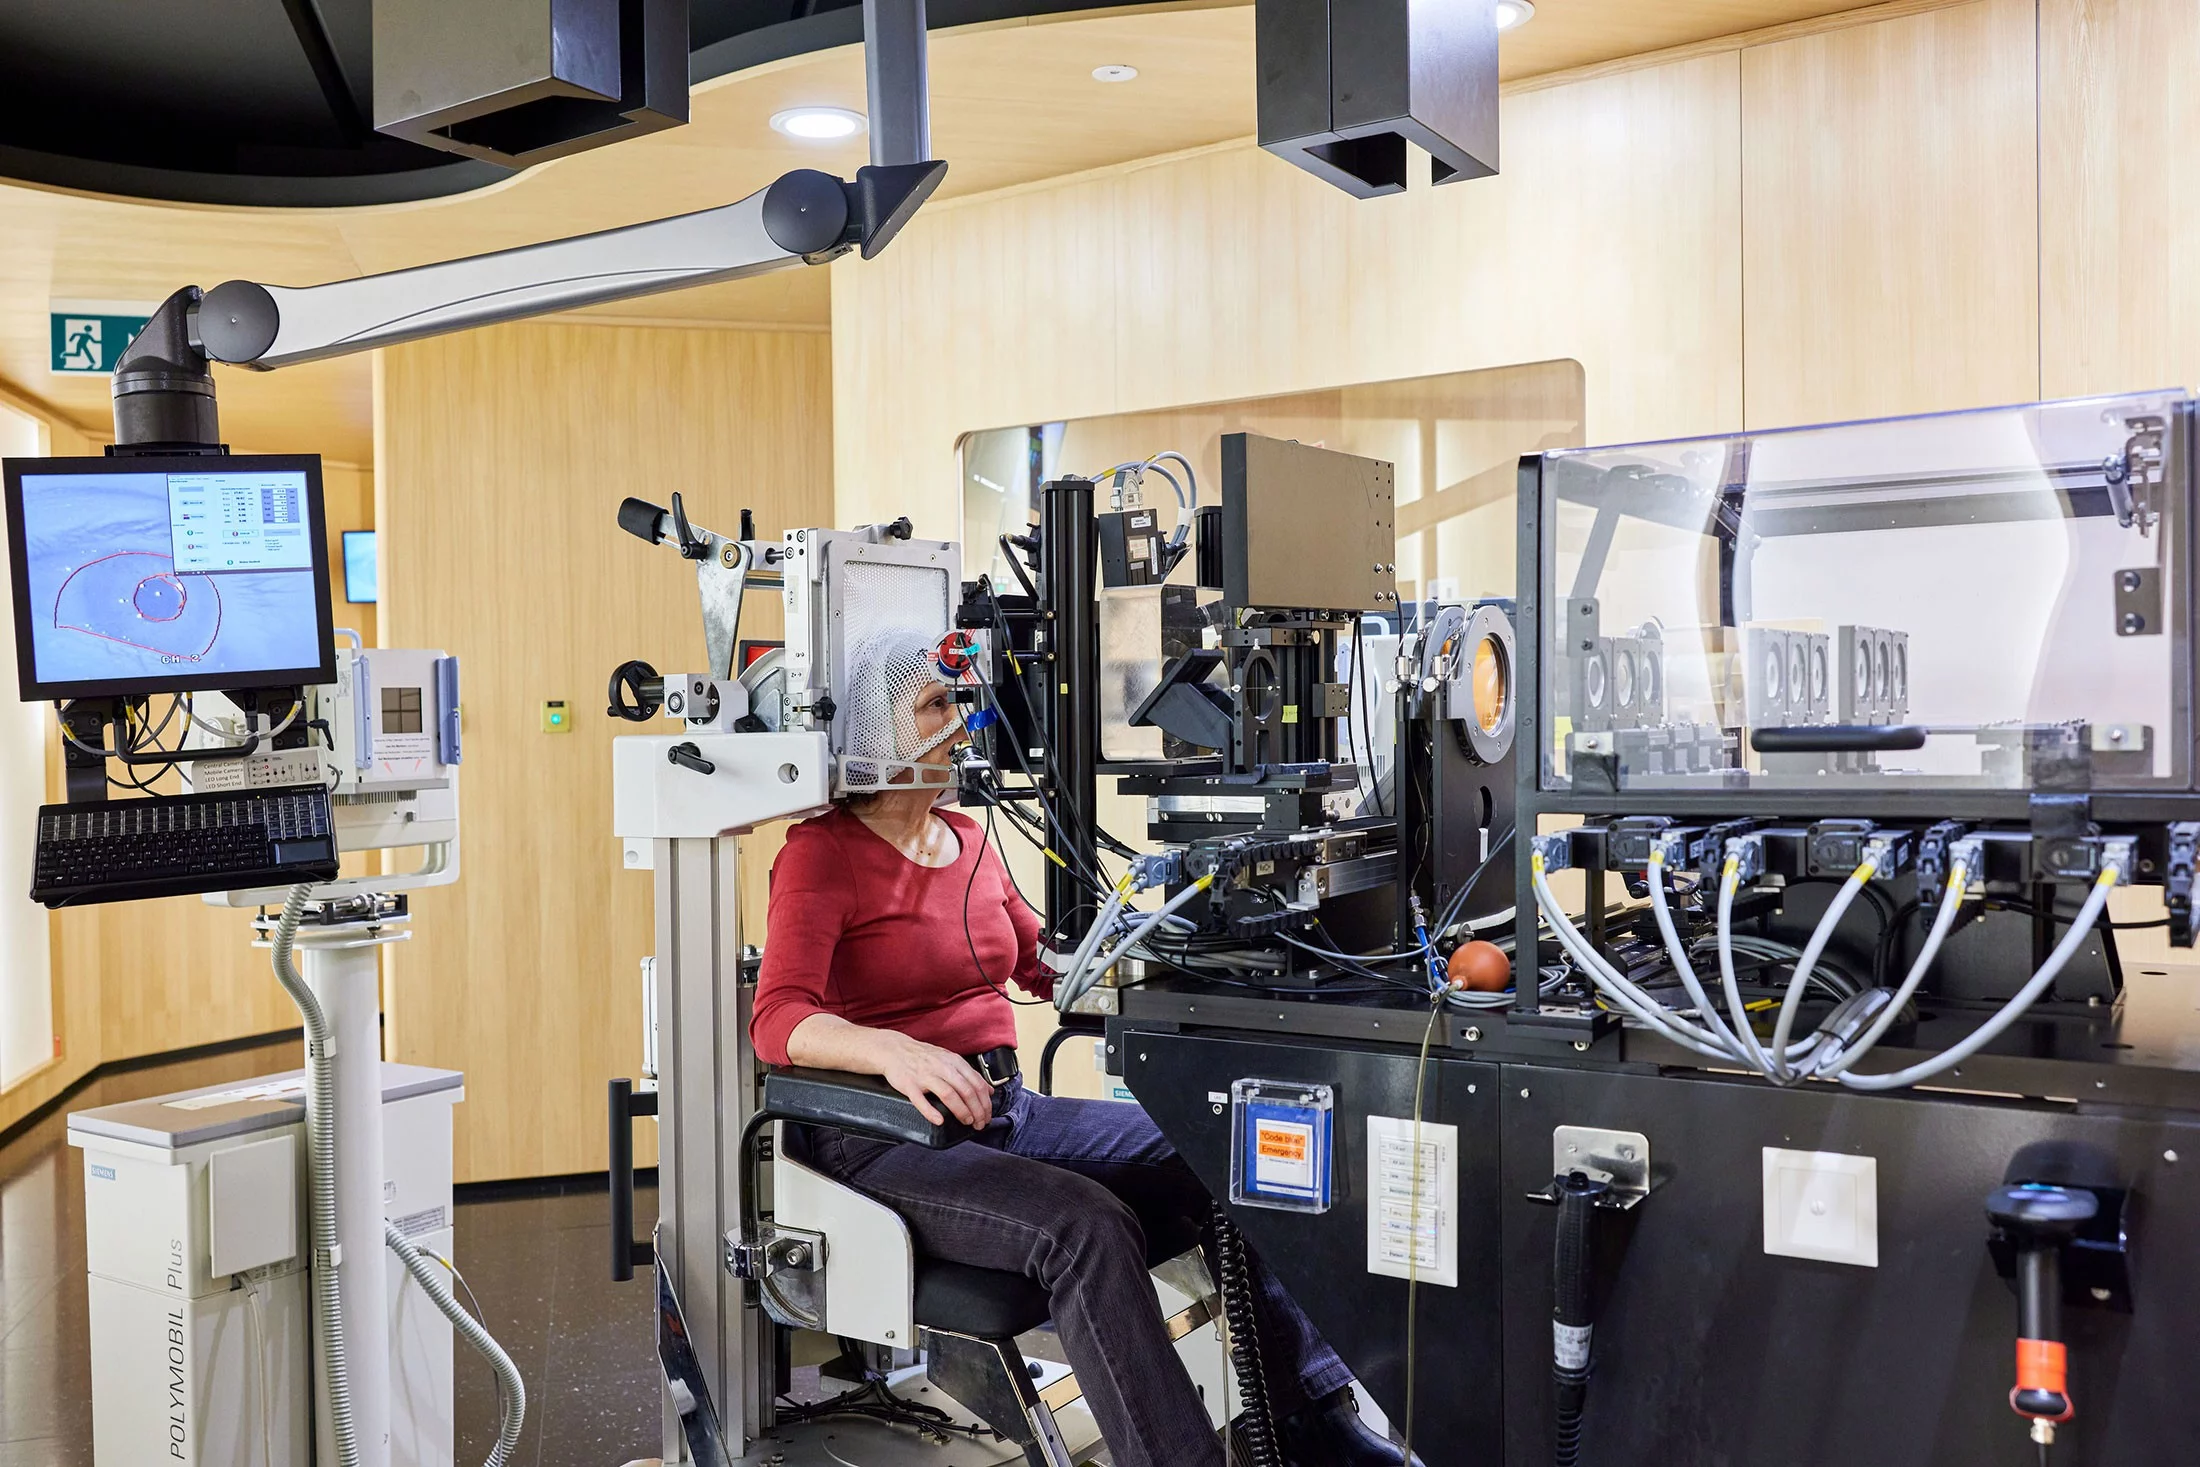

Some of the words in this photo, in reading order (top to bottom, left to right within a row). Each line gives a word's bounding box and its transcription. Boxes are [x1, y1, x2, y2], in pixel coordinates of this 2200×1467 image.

[161, 655, 180, 664] CH
[190, 654, 200, 662] 2
[1262, 1145, 1302, 1159] Emergency
[167, 1239, 183, 1290] Plus
[168, 1307, 185, 1460] POLYMOBIL
